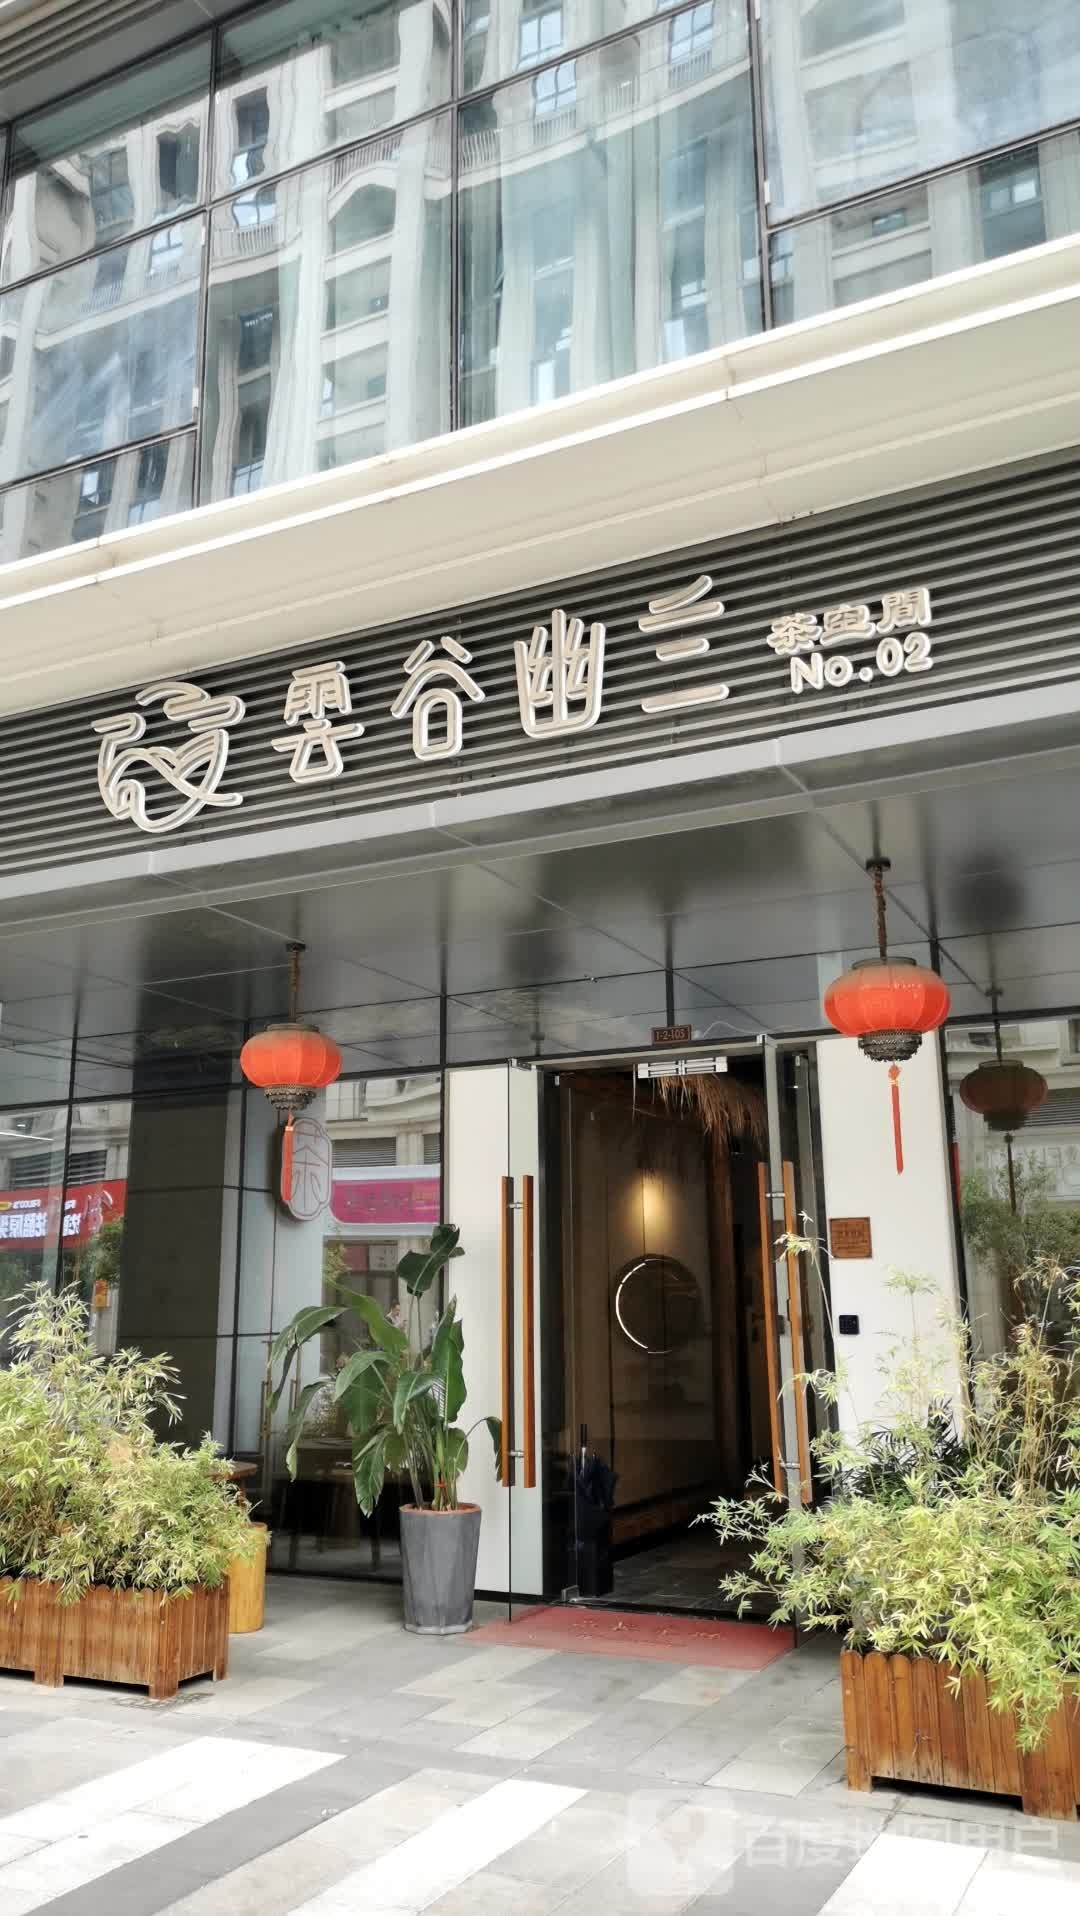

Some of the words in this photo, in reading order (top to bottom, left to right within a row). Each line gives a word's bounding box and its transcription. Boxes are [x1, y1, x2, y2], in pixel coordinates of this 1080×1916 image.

[766, 587, 932, 655] 茶空間
[790, 631, 934, 694] No.02
